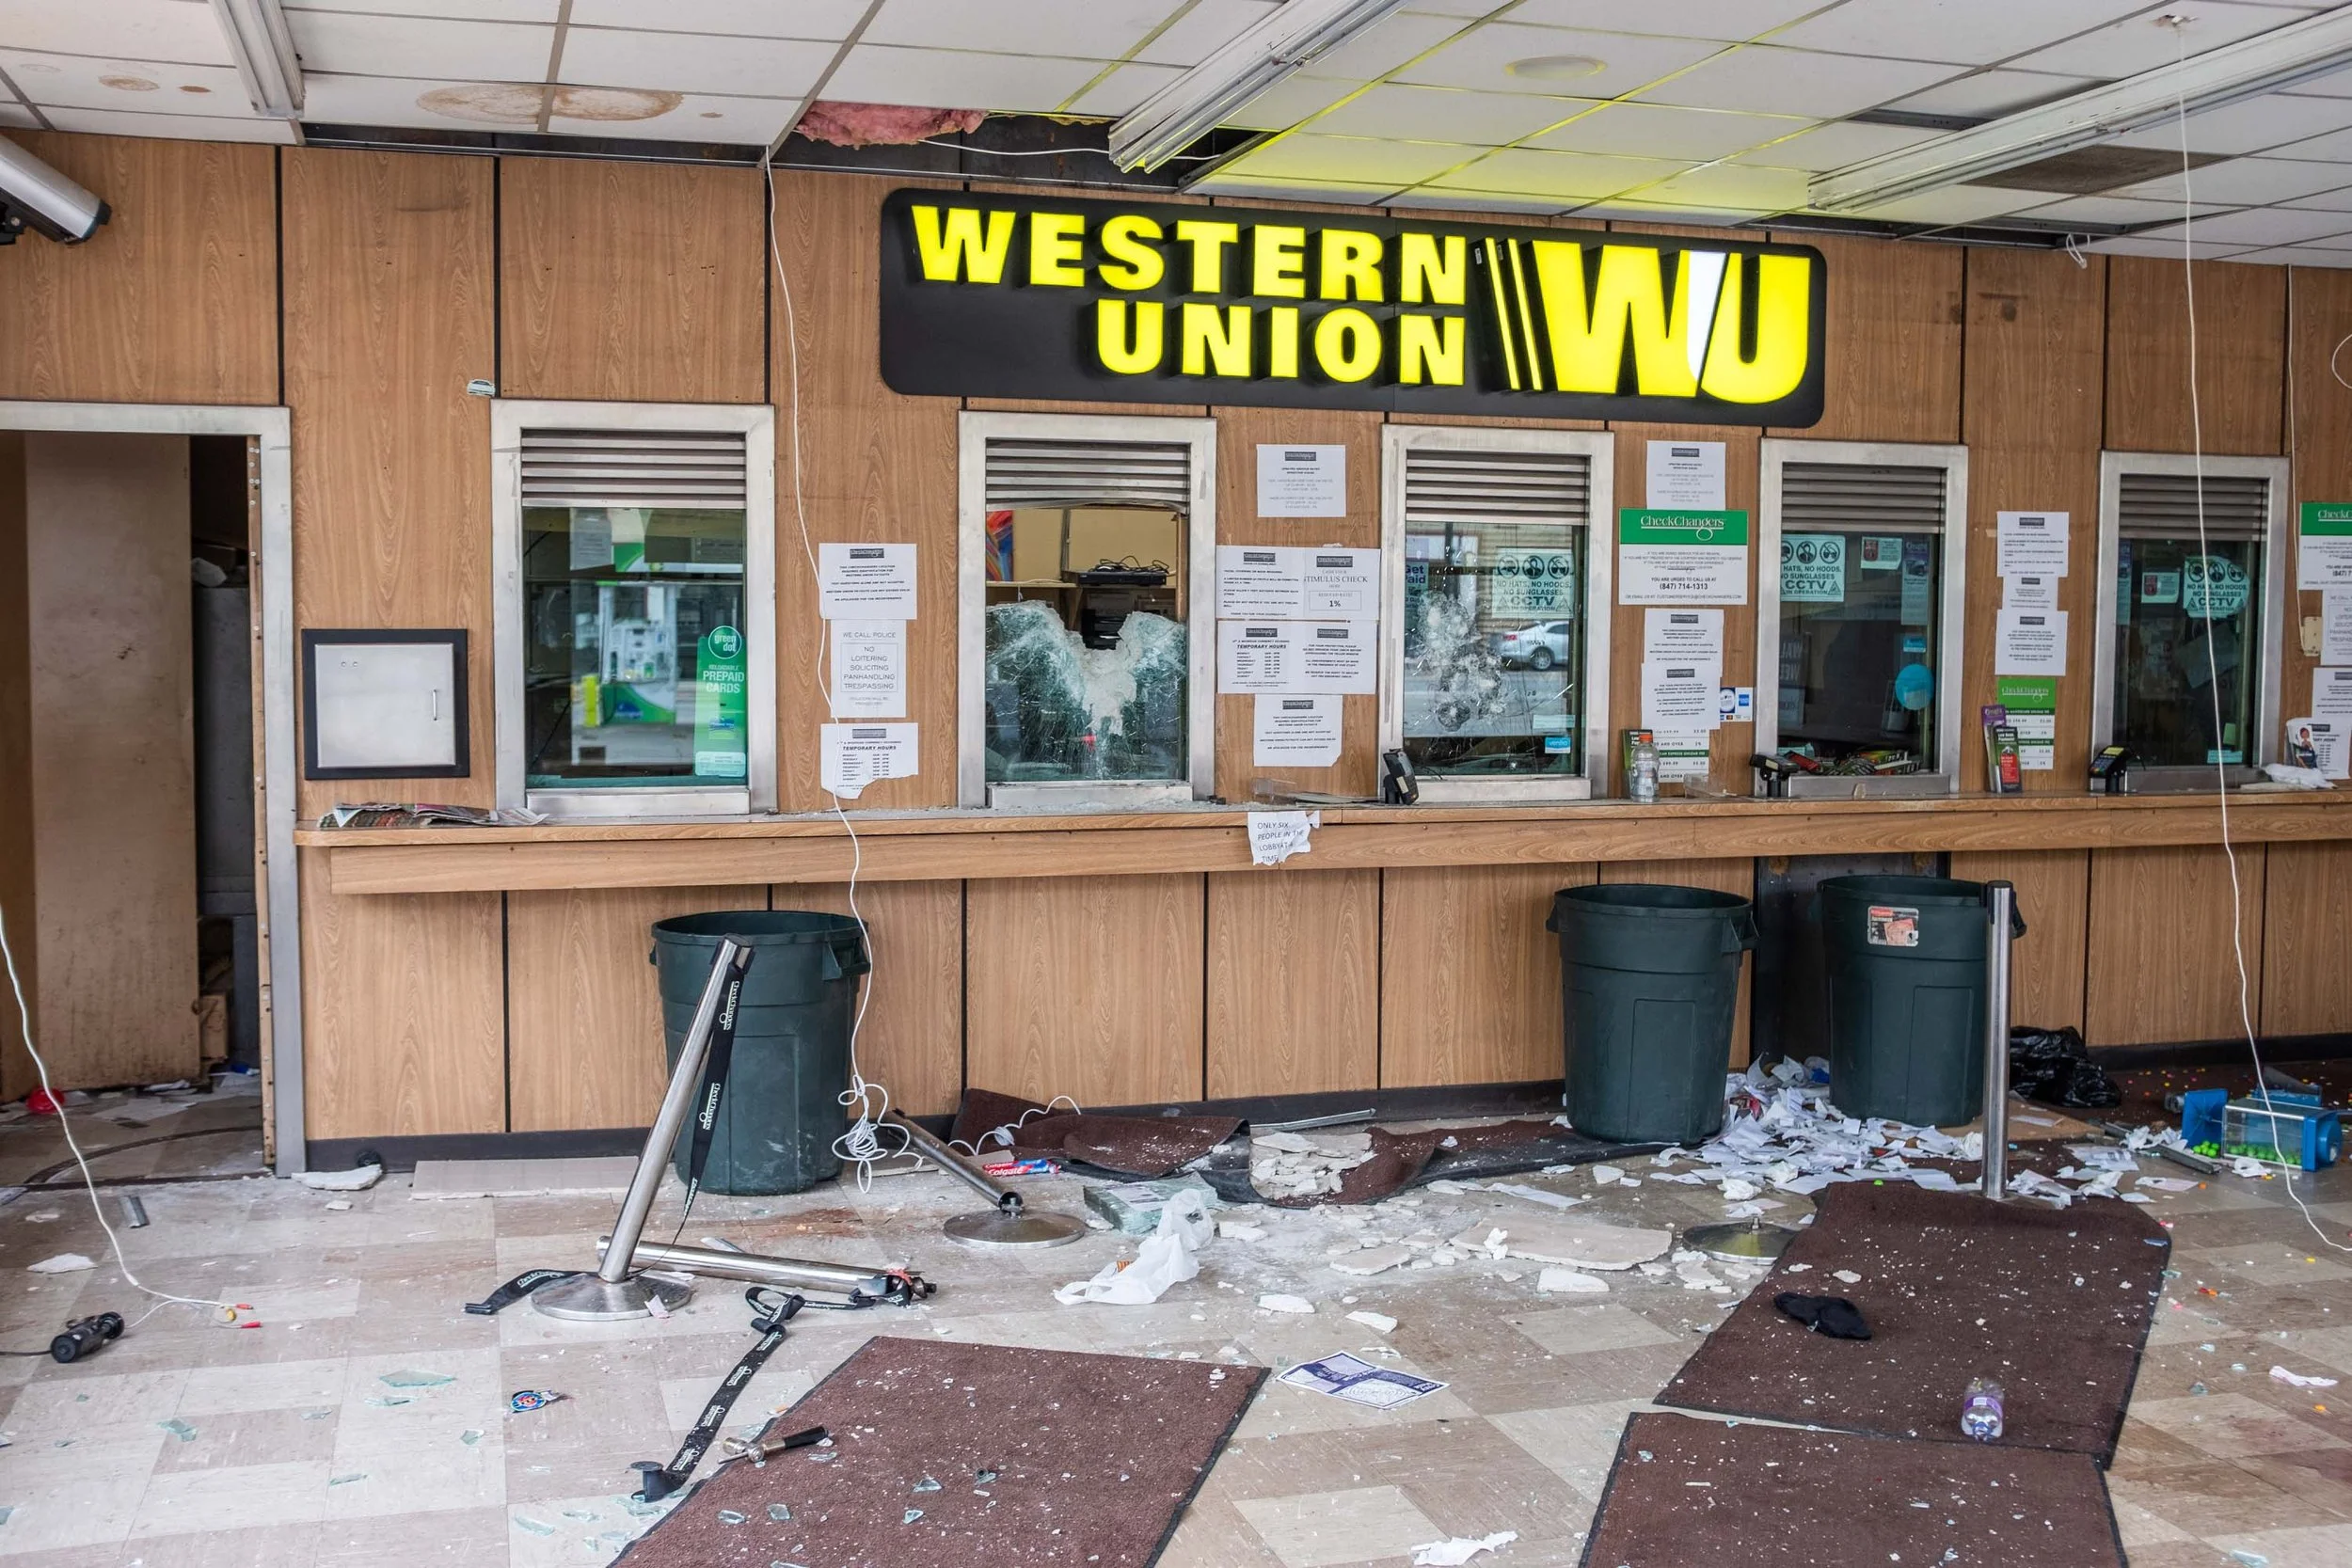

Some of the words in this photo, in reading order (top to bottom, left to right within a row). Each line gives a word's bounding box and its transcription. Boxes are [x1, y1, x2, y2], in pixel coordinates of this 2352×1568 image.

[912, 205, 1467, 305] WESTERN
[1533, 240, 1810, 404] WU
[1097, 298, 1466, 386] UNION
[1640, 515, 1724, 541] CheckChangers
[1406, 575, 1426, 583] aid
[1785, 579, 1826, 590] CCTV
[1511, 595, 1555, 606] CCTV
[2198, 597, 2234, 606] CCTV
[714, 634, 737, 644] green
[723, 643, 737, 652] dot
[703, 671, 745, 682] PREPAID
[706, 683, 740, 693] CARDS
[1257, 832, 1281, 841] PEOPLE
[1259, 843, 1279, 851] LOBBY
[988, 1166, 1024, 1176] Colgate
